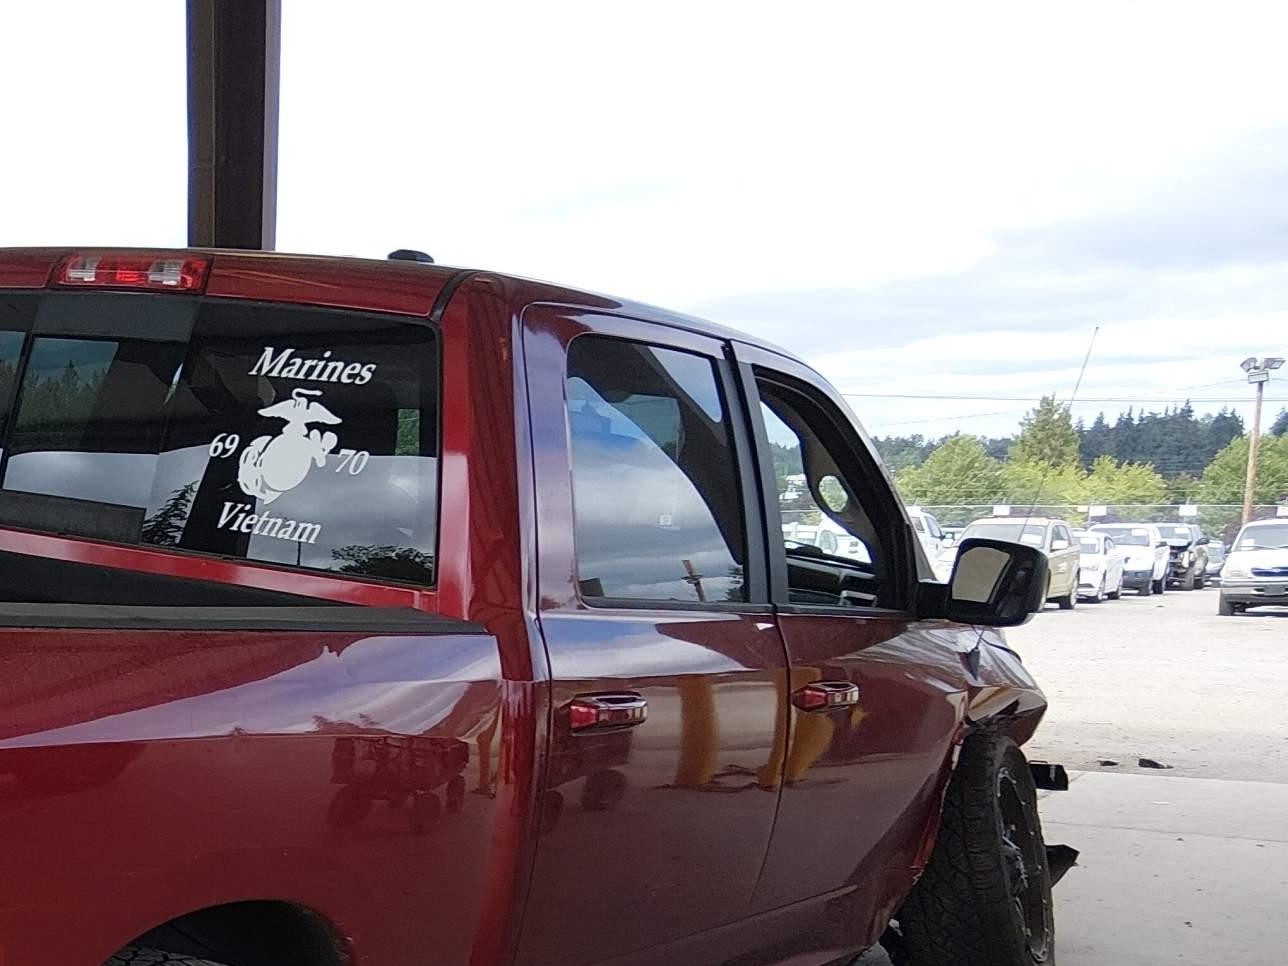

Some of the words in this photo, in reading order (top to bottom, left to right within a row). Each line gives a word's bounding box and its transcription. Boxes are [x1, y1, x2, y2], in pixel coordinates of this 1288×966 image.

[248, 346, 377, 385] Marines
[209, 433, 240, 458] 69
[335, 449, 370, 475] 70
[216, 502, 322, 544] Vietnam
